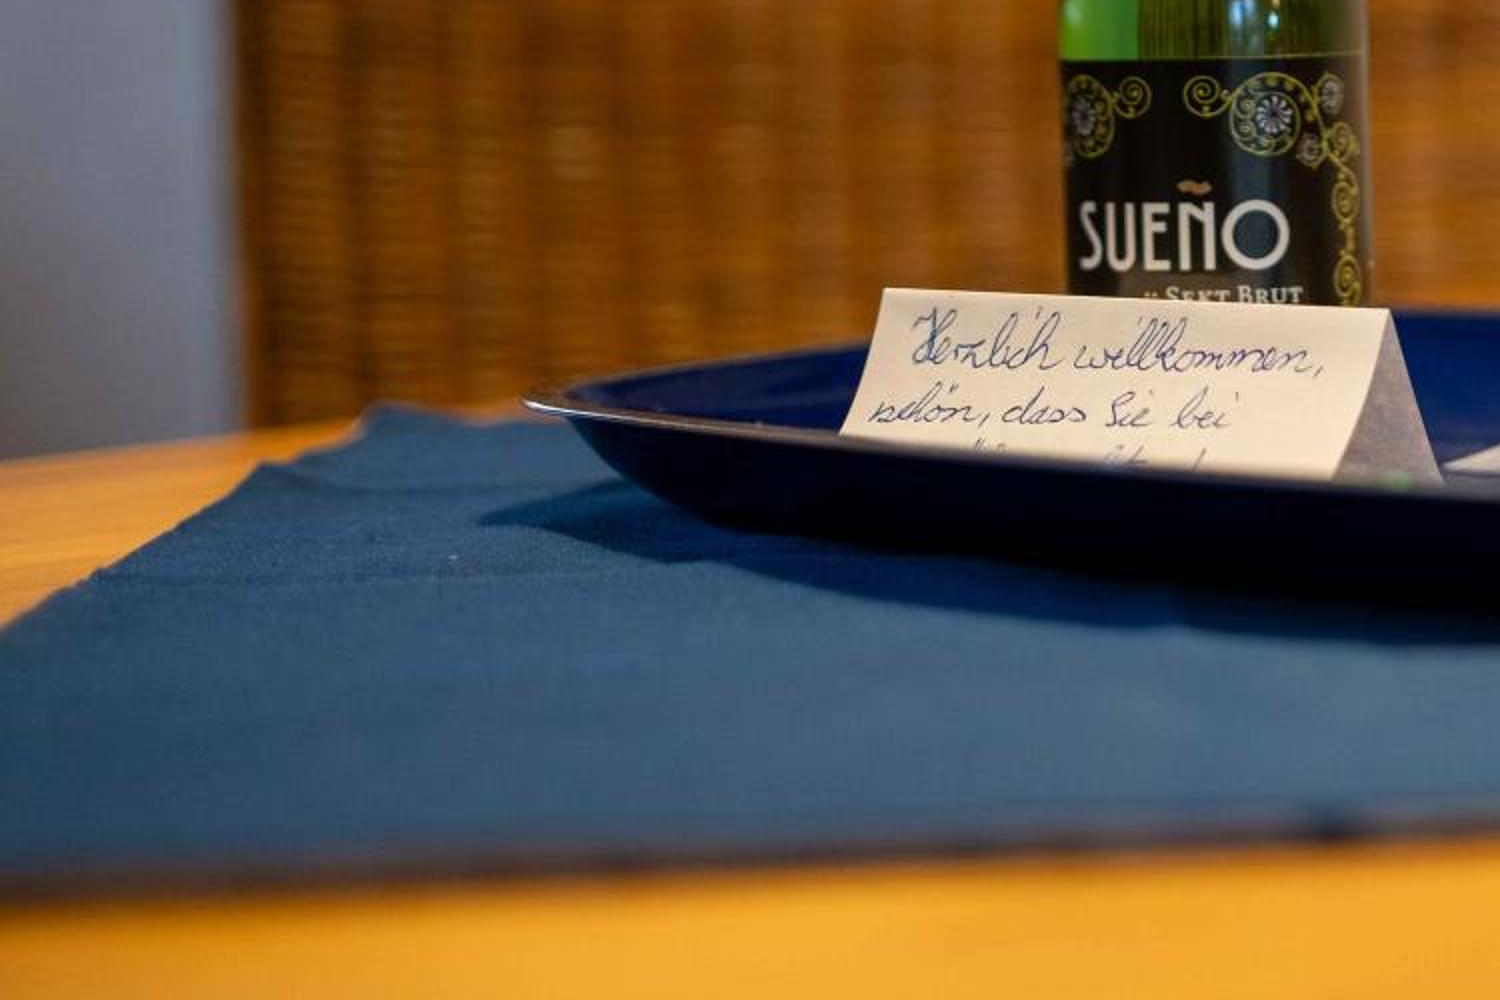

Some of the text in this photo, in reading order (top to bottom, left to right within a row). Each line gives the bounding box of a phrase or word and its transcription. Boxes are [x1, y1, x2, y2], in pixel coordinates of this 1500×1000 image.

[1079, 179, 1290, 272] SUEÑO
[1237, 285, 1303, 305] BRUT
[911, 306, 1324, 377] Herzlich willkommen,
[868, 381, 1239, 429] schön, dass Sie bei
